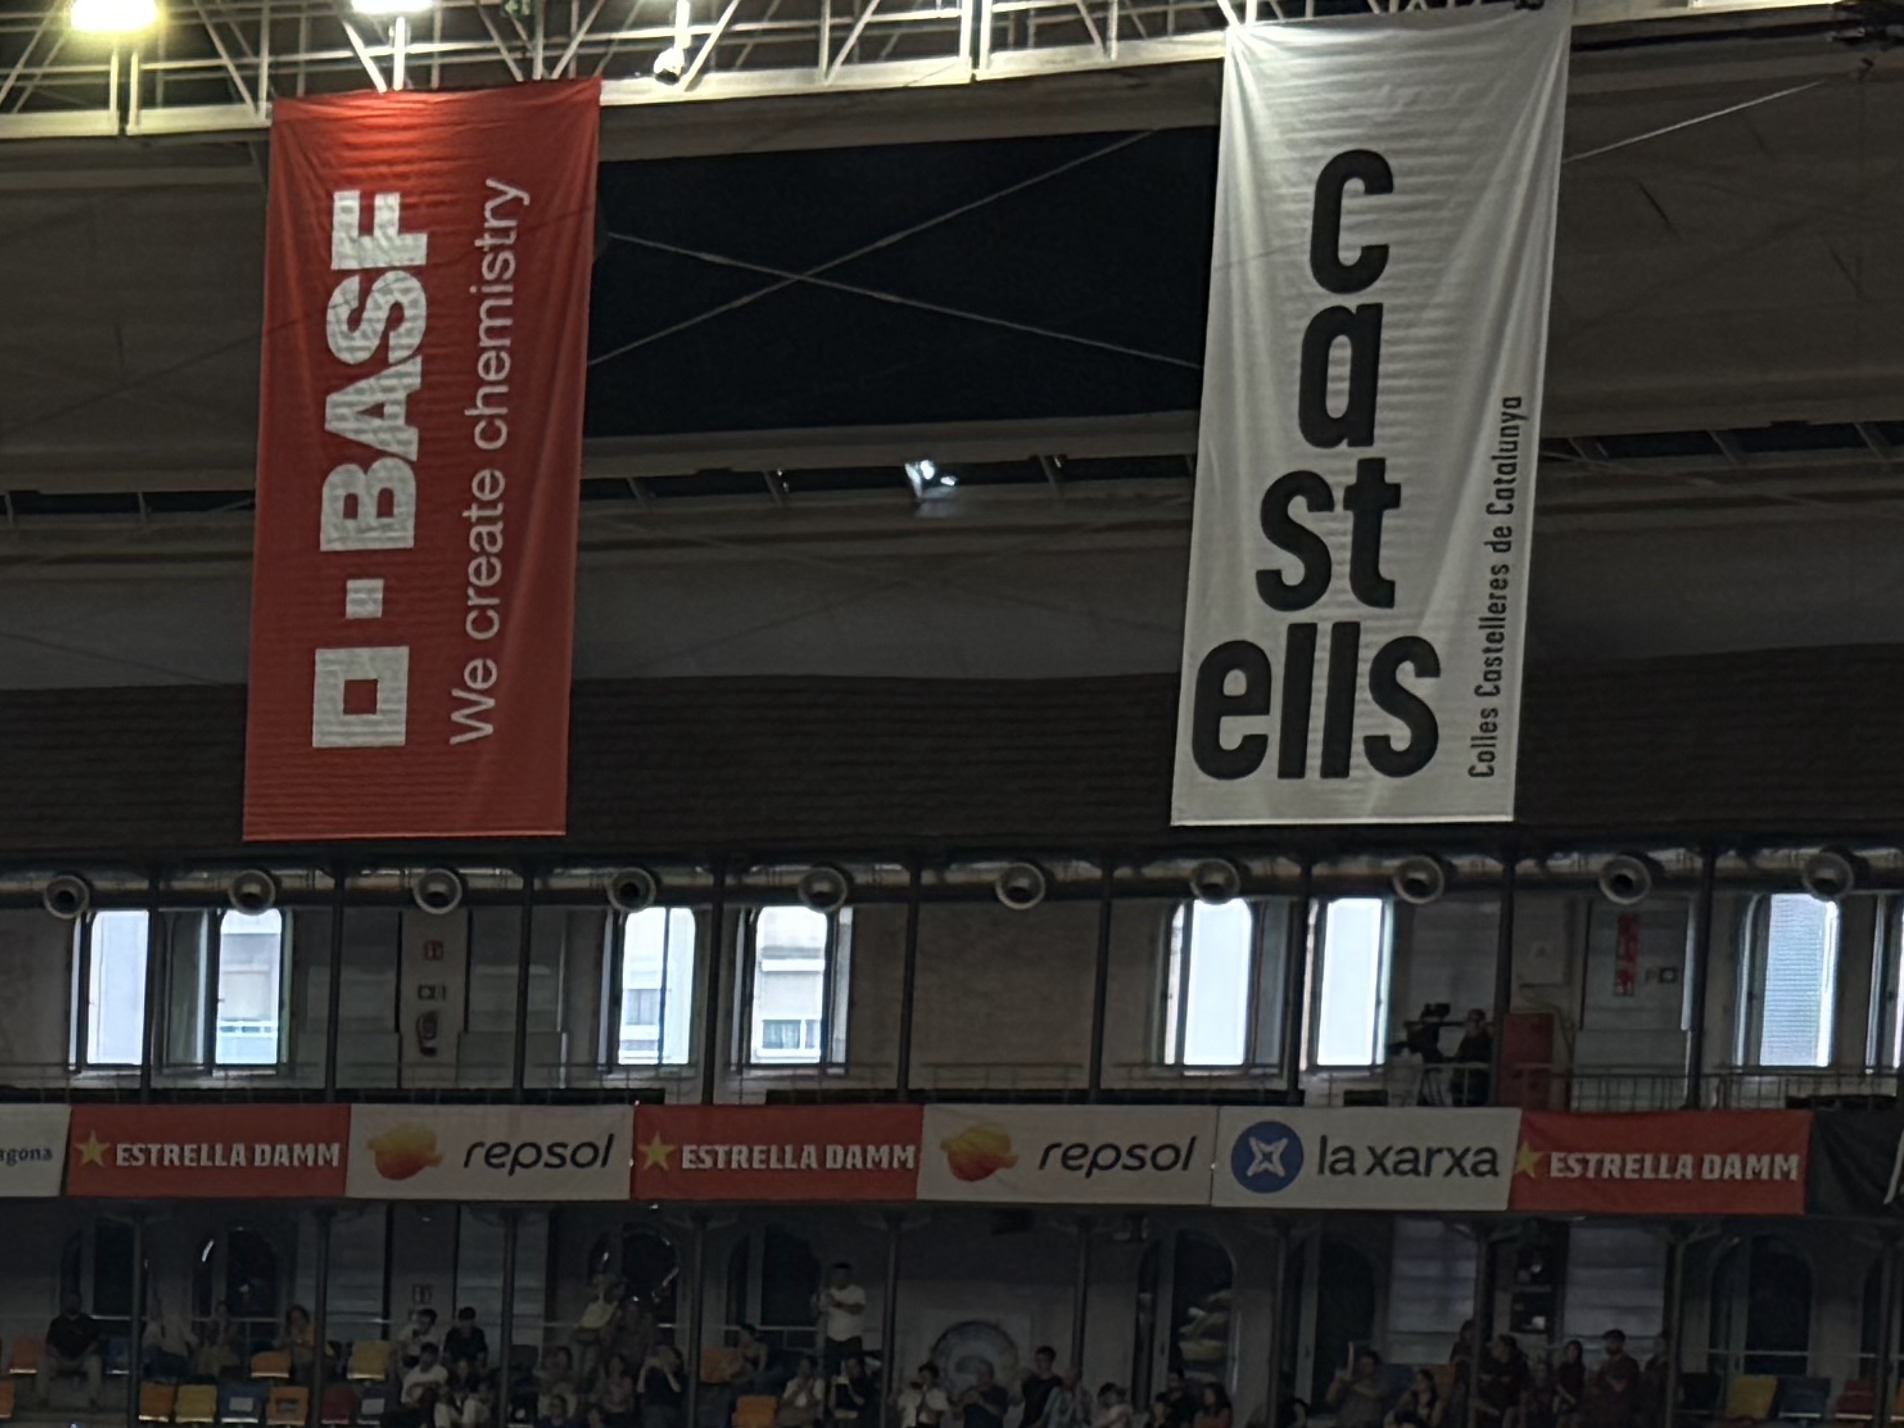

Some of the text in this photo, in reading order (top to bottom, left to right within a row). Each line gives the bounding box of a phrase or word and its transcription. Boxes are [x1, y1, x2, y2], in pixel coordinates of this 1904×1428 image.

[324, 190, 428, 552] BASF
[450, 178, 530, 746] We create chemistry
[1468, 395, 1530, 778] Colles Castelleres de Catalunya
[115, 1142, 341, 1168] ESTRELLA DAMM
[463, 1133, 615, 1176] repsol
[681, 1144, 916, 1170] ESTRELLA DAMM
[1038, 1136, 1197, 1179] repsol
[1549, 1151, 1799, 1180] ESTRELLA DAMM
